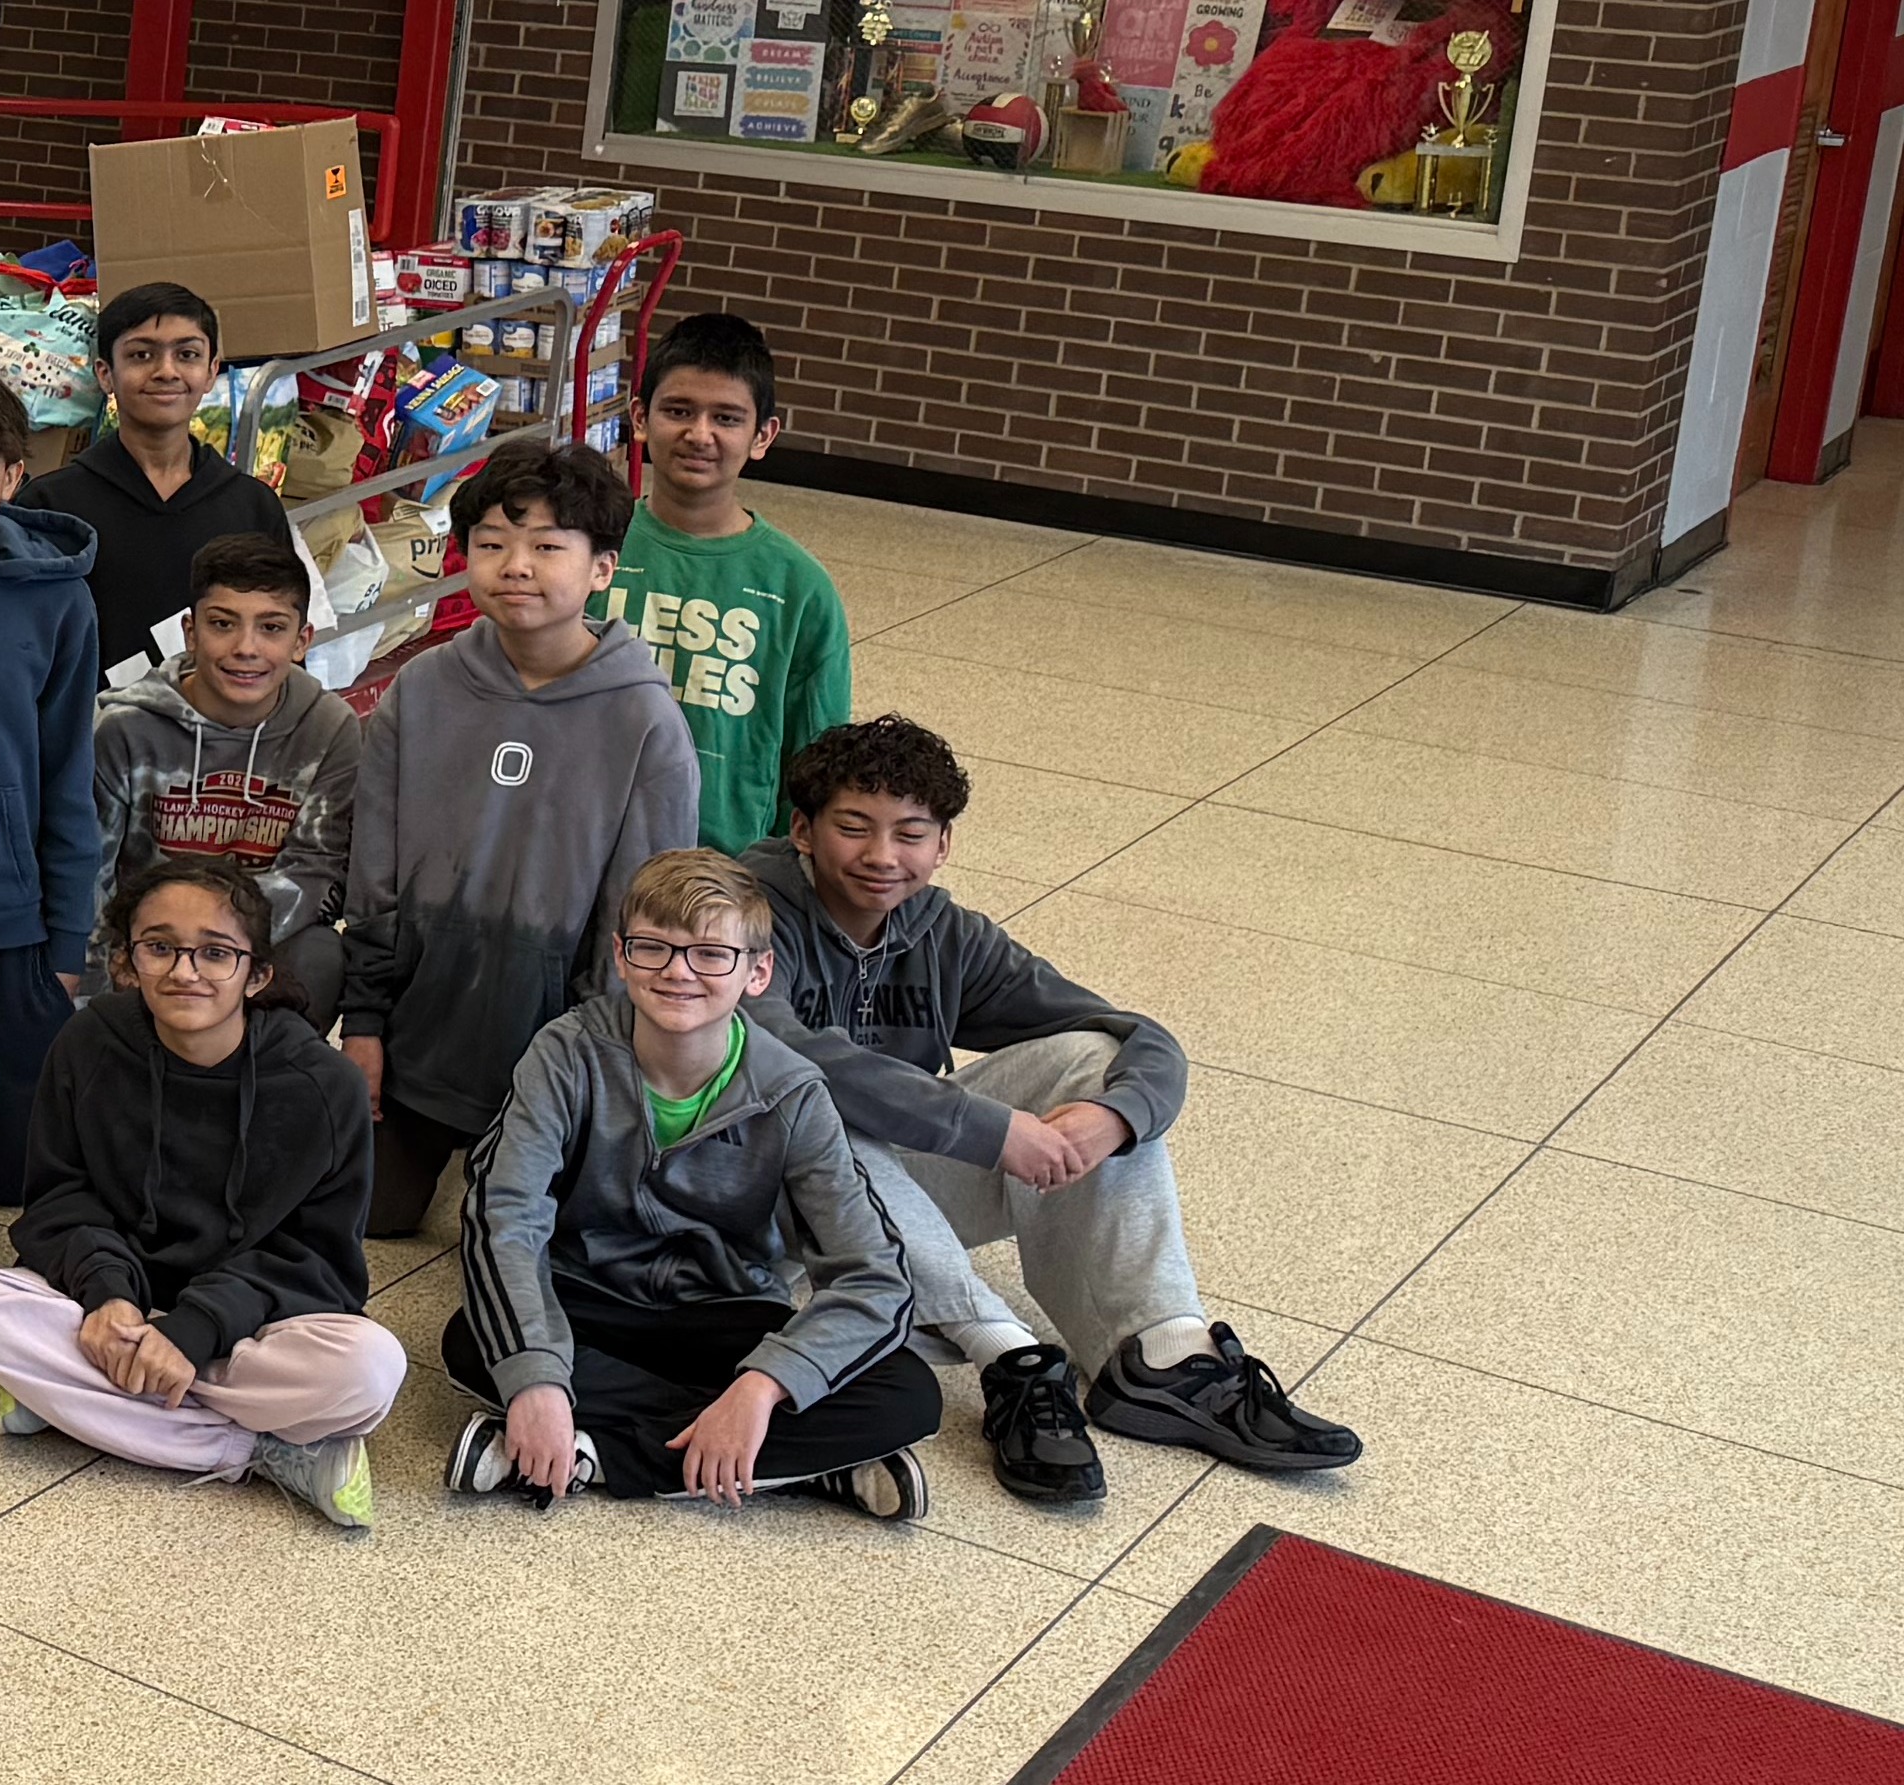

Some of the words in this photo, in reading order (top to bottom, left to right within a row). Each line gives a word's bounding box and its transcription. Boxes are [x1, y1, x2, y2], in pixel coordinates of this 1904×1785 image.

[1196, 4, 1245, 19] GROWING
[953, 68, 1012, 85] Acceptance
[1194, 84, 1215, 99] Be
[747, 122, 798, 132] ACHIEVE
[426, 268, 458, 279] ORGANIC
[423, 279, 458, 292] DICED
[410, 533, 449, 562] pri
[606, 587, 760, 661] LESS
[219, 774, 248, 787] 202
[203, 803, 245, 819] HOCKEY
[794, 984, 936, 1030] SANNAH
